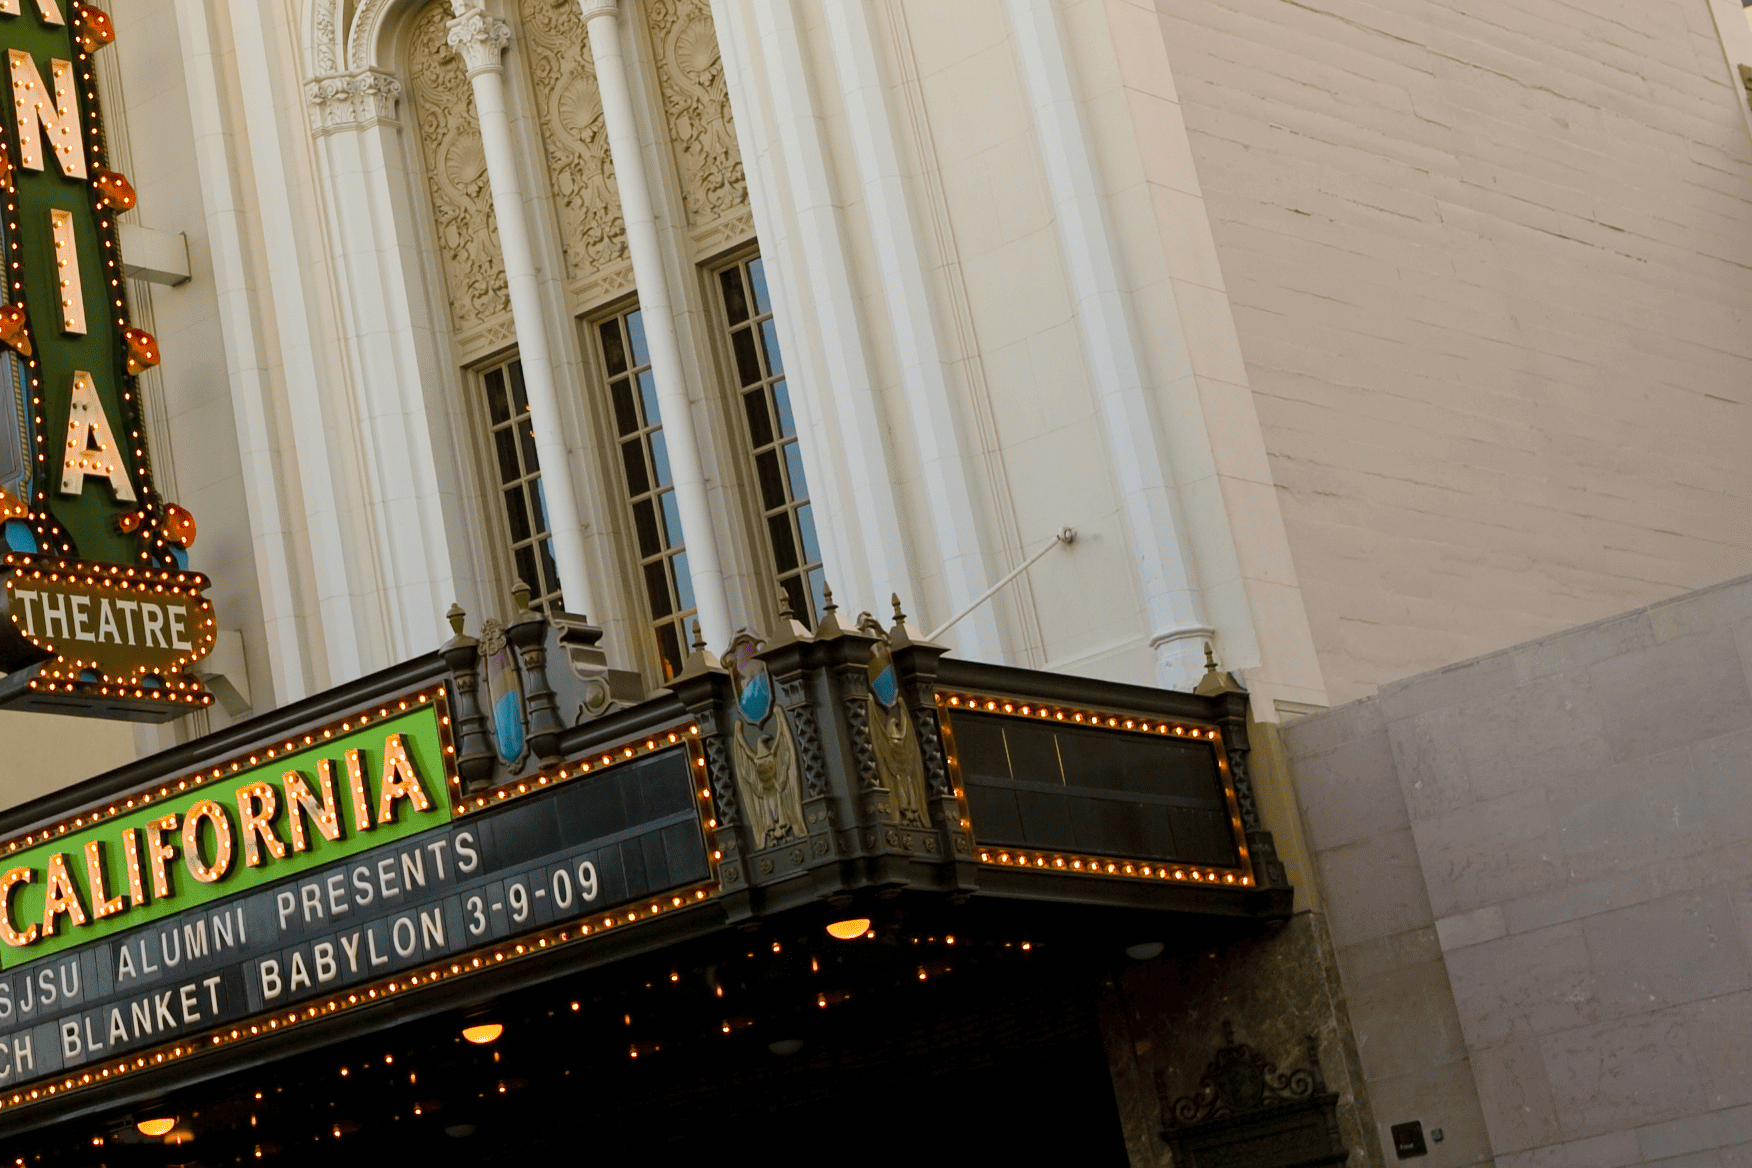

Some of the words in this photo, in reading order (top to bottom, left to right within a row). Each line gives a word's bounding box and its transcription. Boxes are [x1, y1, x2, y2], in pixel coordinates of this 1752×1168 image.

[13, 587, 193, 652] THEATRE
[61, 975, 222, 1059] BLANKET
[259, 906, 446, 1001] BABYLON
[466, 860, 599, 937] 3-9-09
[118, 906, 247, 982] ALUMNI
[276, 831, 479, 931] PRESENTS
